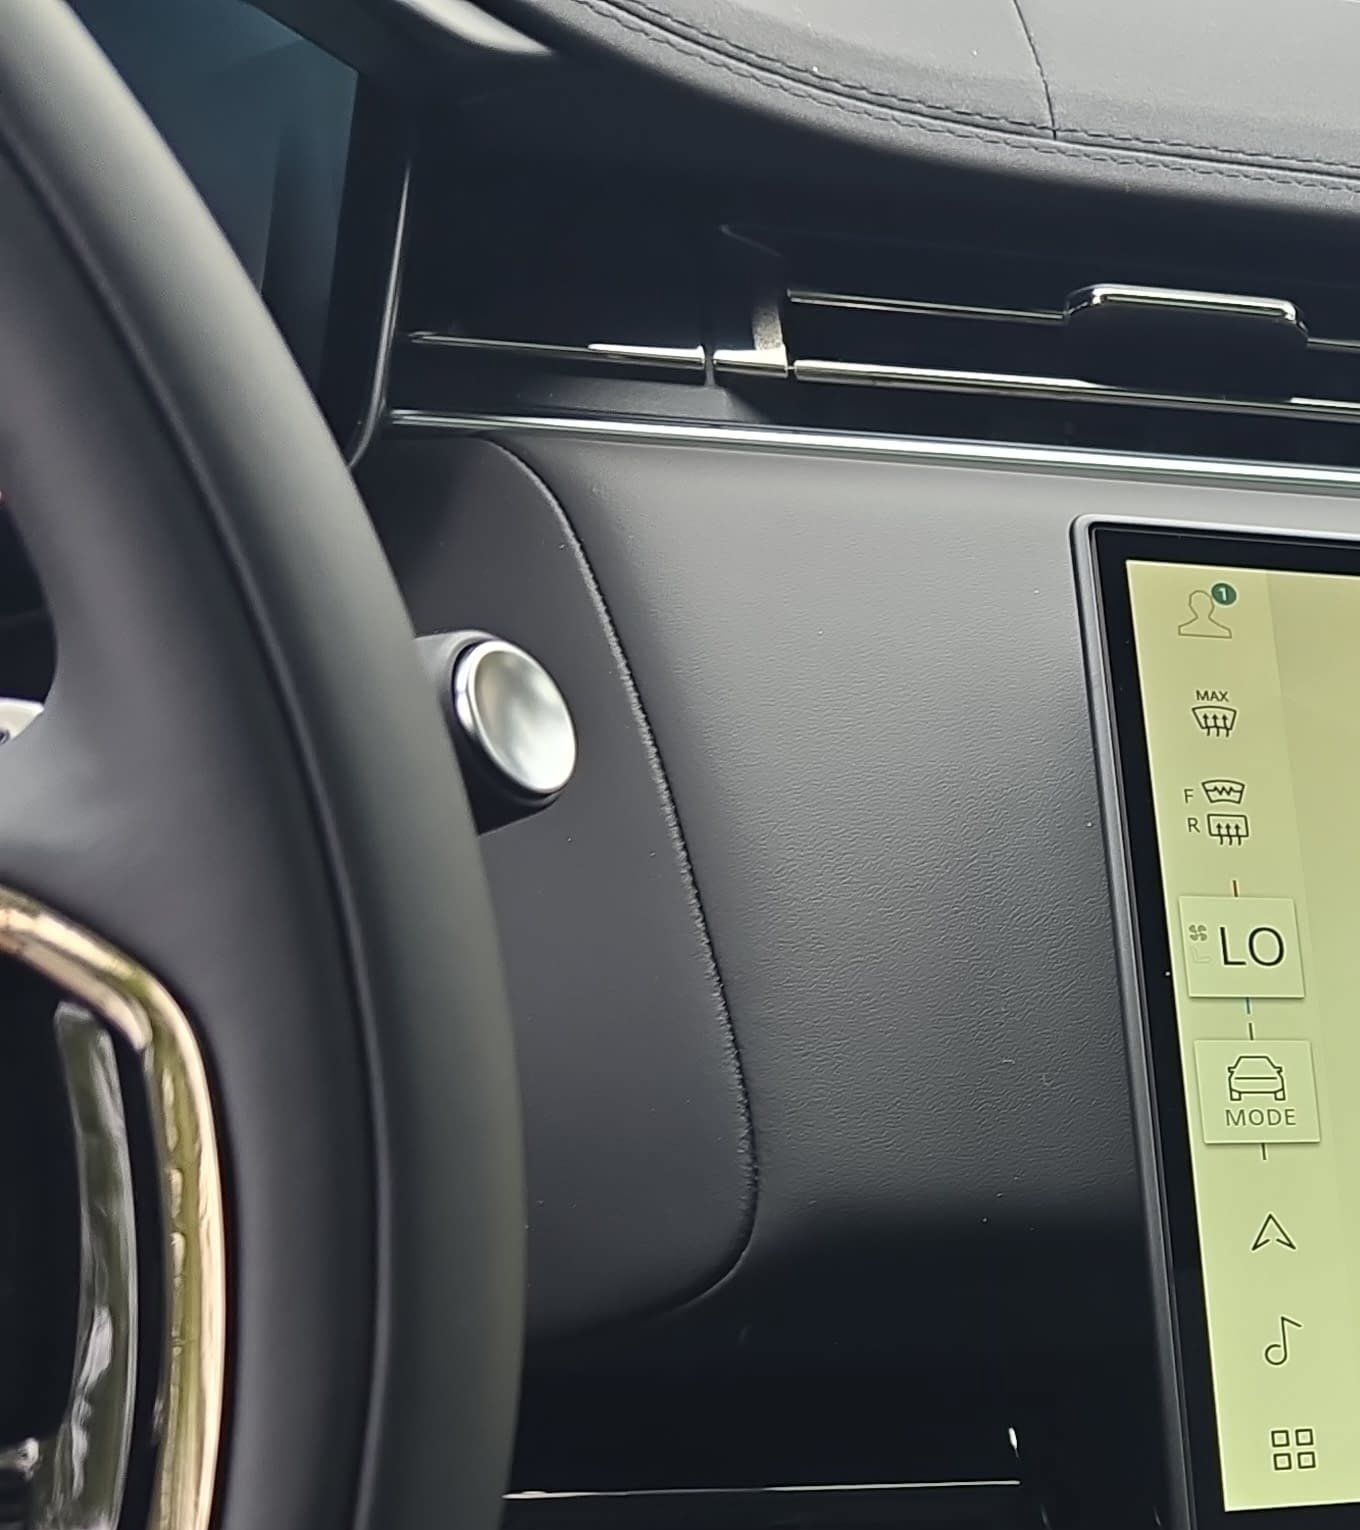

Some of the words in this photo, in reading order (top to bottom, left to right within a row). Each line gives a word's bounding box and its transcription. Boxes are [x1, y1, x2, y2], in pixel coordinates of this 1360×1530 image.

[1195, 690, 1229, 703] MAX
[1183, 789, 1194, 804] F
[1187, 817, 1201, 834] R
[1219, 926, 1285, 967] LO
[1225, 1109, 1297, 1127] MODE
